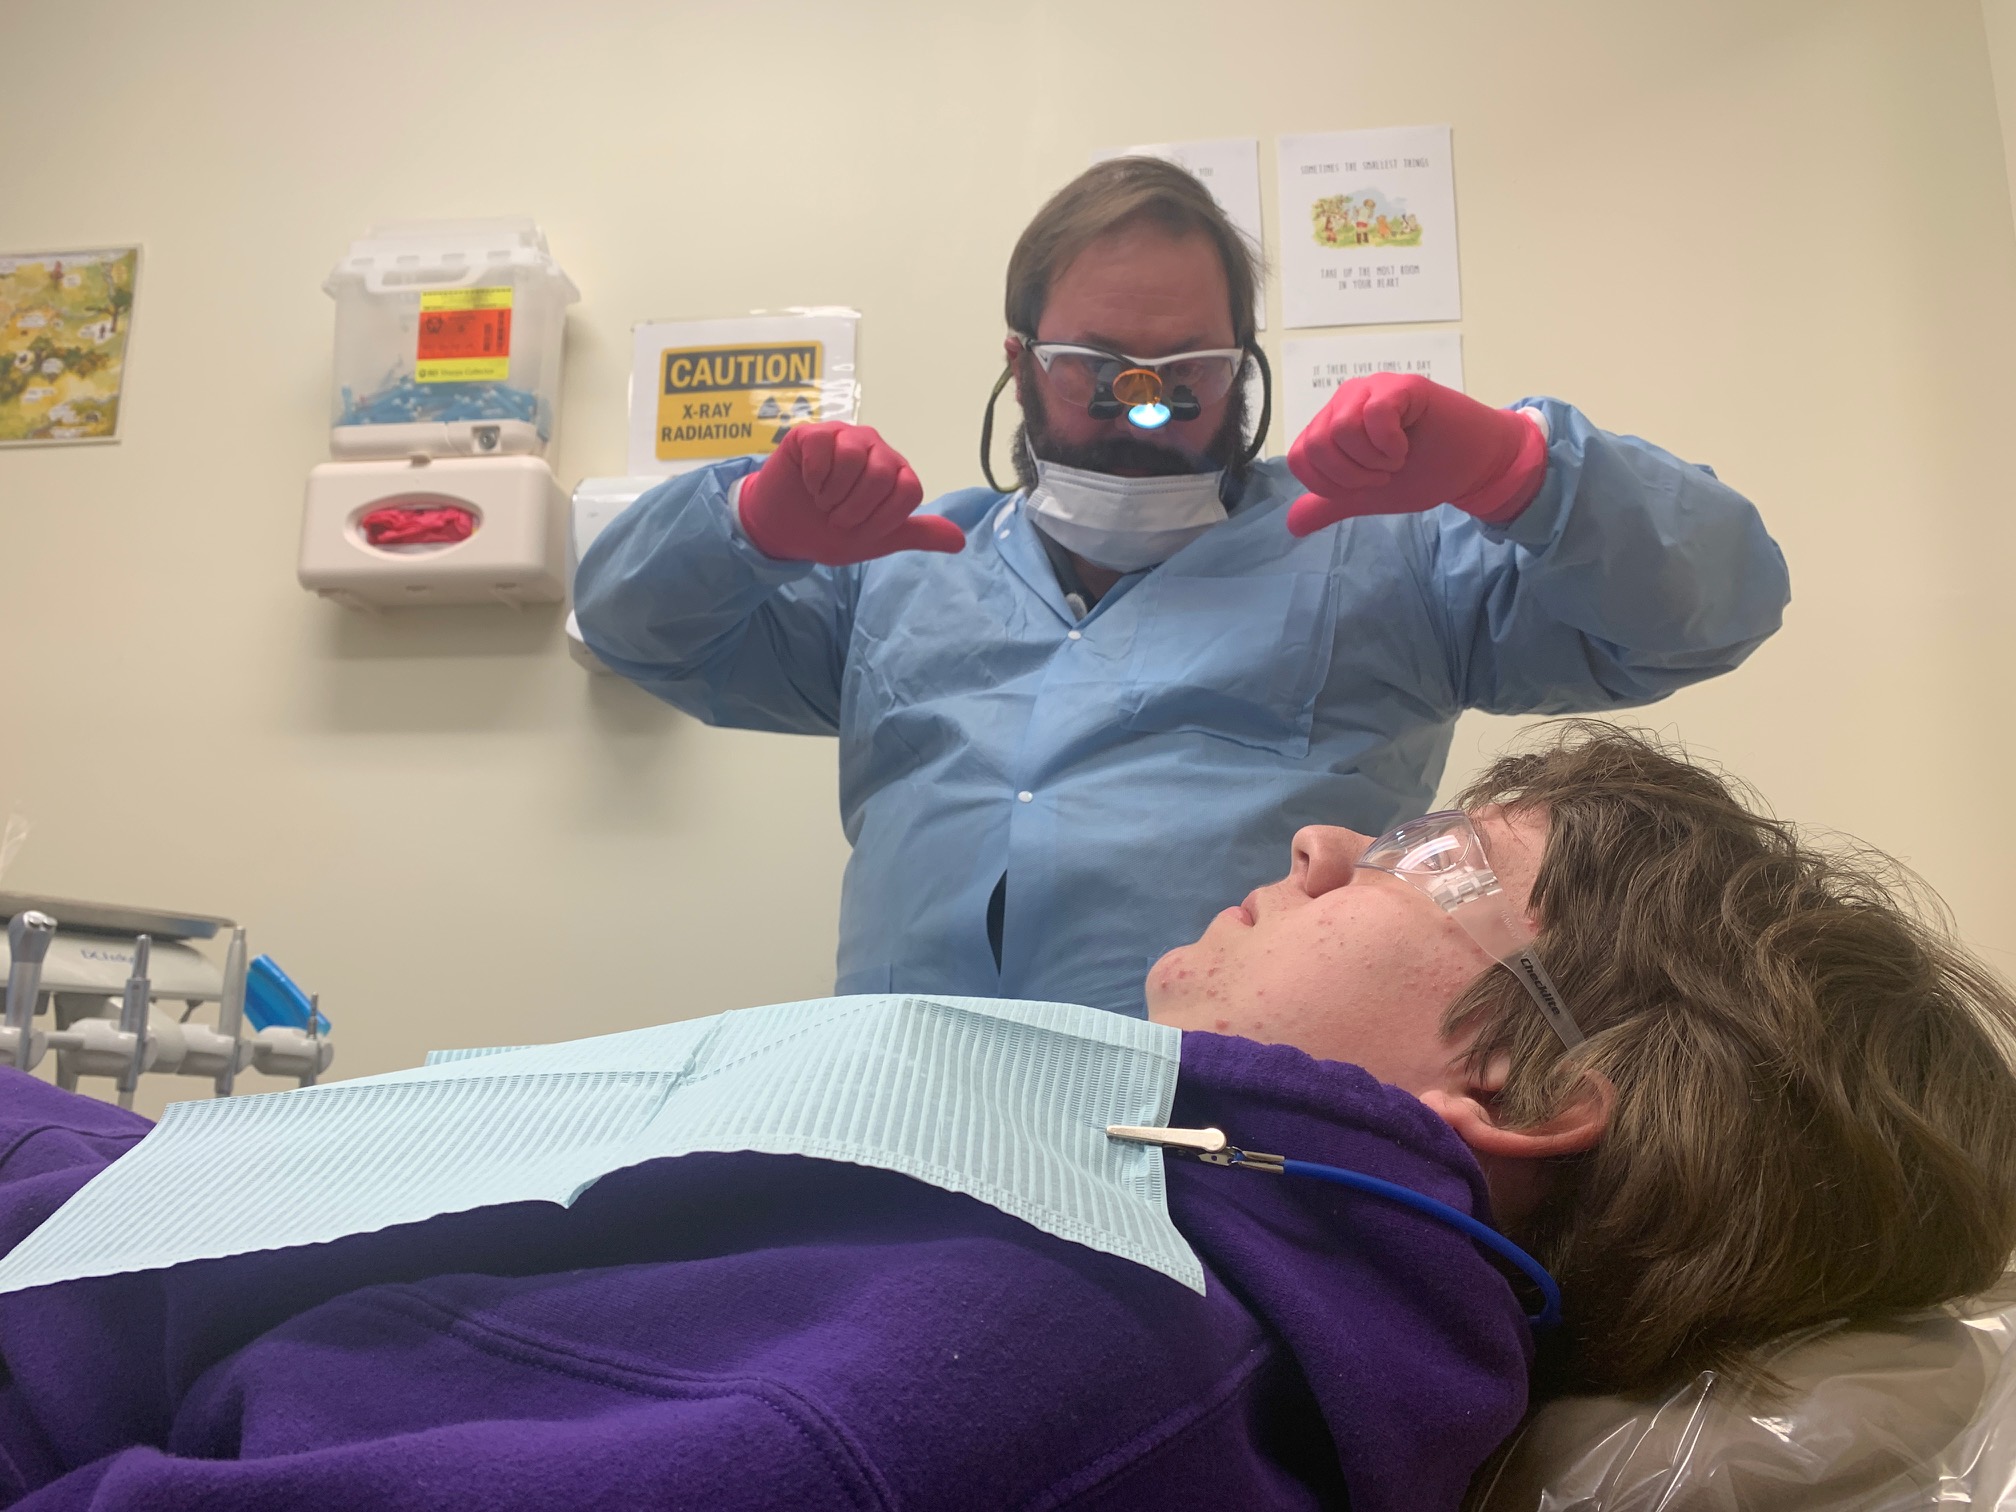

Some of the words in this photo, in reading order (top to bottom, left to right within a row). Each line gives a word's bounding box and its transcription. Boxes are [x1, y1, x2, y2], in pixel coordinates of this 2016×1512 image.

[1300, 163, 1340, 174] SOMETIMES
[1345, 162, 1357, 172] THE
[1361, 159, 1398, 170] SMALLEST
[1403, 158, 1430, 168] THINGS
[1320, 268, 1338, 279] TAKE
[1343, 267, 1353, 278] UP
[1358, 266, 1371, 277] THE
[1376, 265, 1395, 276] MOST
[1400, 264, 1420, 275] ROOM
[1338, 280, 1347, 291] IN
[1353, 279, 1372, 289] YOUR
[1376, 277, 1399, 288] HEART
[669, 353, 811, 388] CAUTION
[1313, 365, 1320, 376] IF
[1326, 364, 1348, 375] THERE
[1353, 362, 1373, 374] EVER
[1377, 361, 1401, 372] COMES
[1416, 360, 1431, 370] DAY
[1312, 376, 1331, 388] WHEN
[682, 402, 733, 419] X-RAY
[661, 423, 753, 442] RADIATION
[1520, 957, 1560, 1015] Checklite
